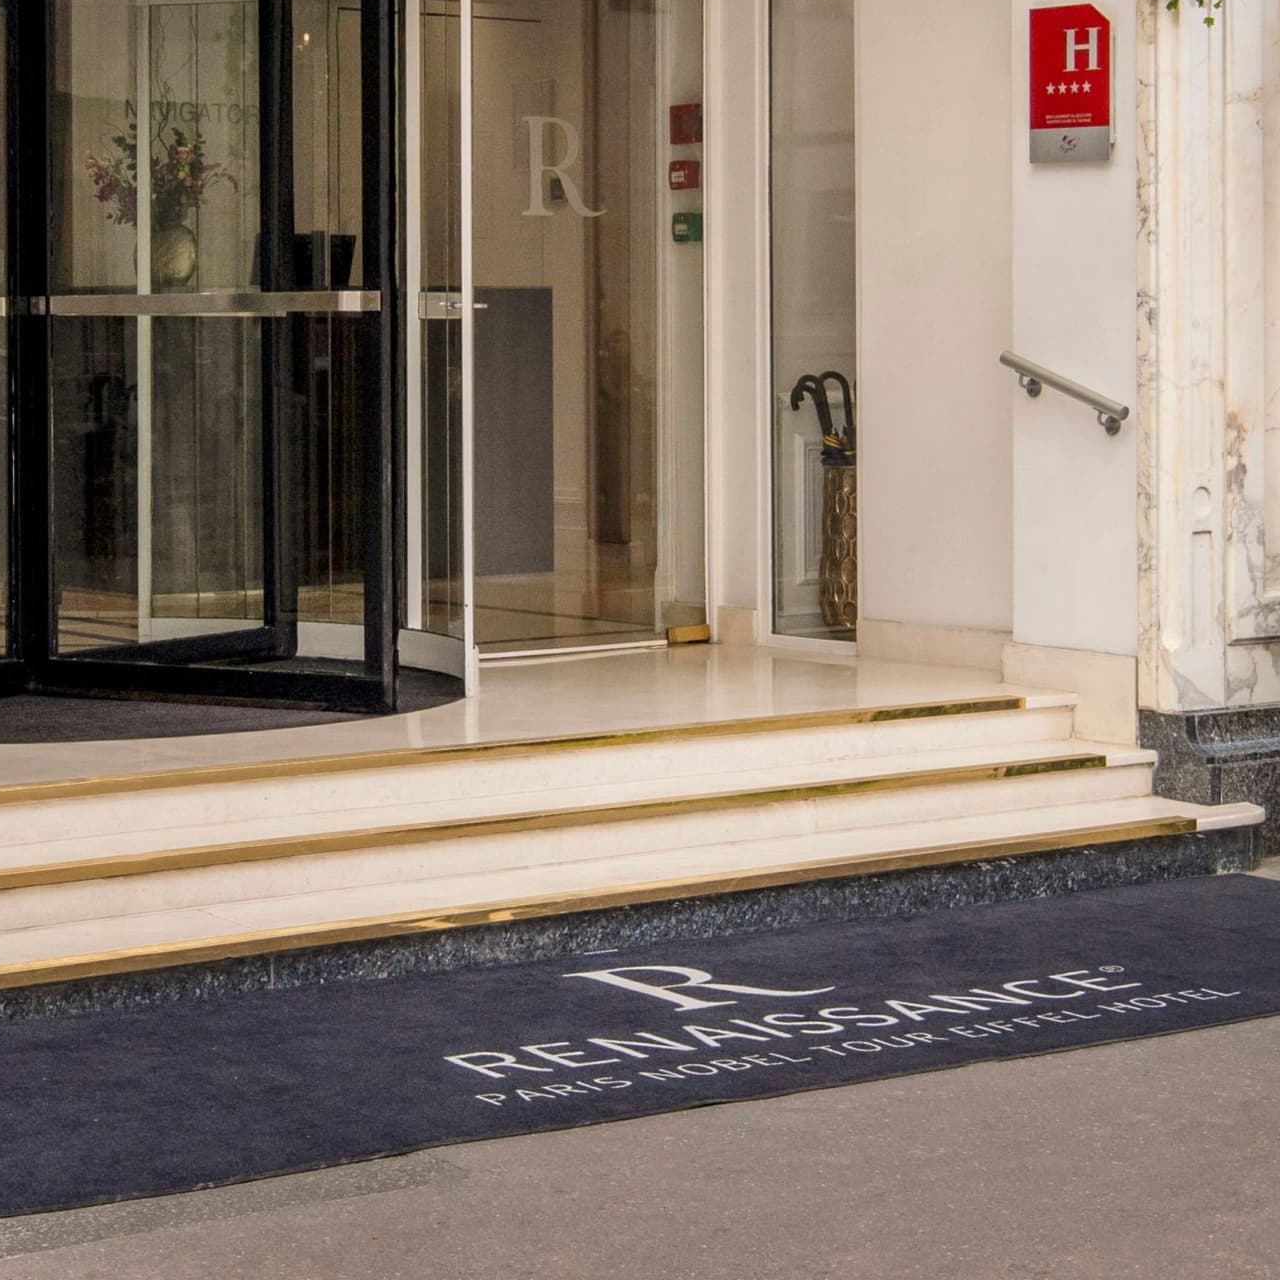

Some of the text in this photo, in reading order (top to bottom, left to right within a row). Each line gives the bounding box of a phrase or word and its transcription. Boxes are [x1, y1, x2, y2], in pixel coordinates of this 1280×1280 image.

[1062, 26, 1103, 73] H
[521, 115, 608, 218] R
[561, 964, 837, 1012] R
[474, 986, 1242, 1107] PARIS NOBEL TOUR EIFFEL HOTEL
